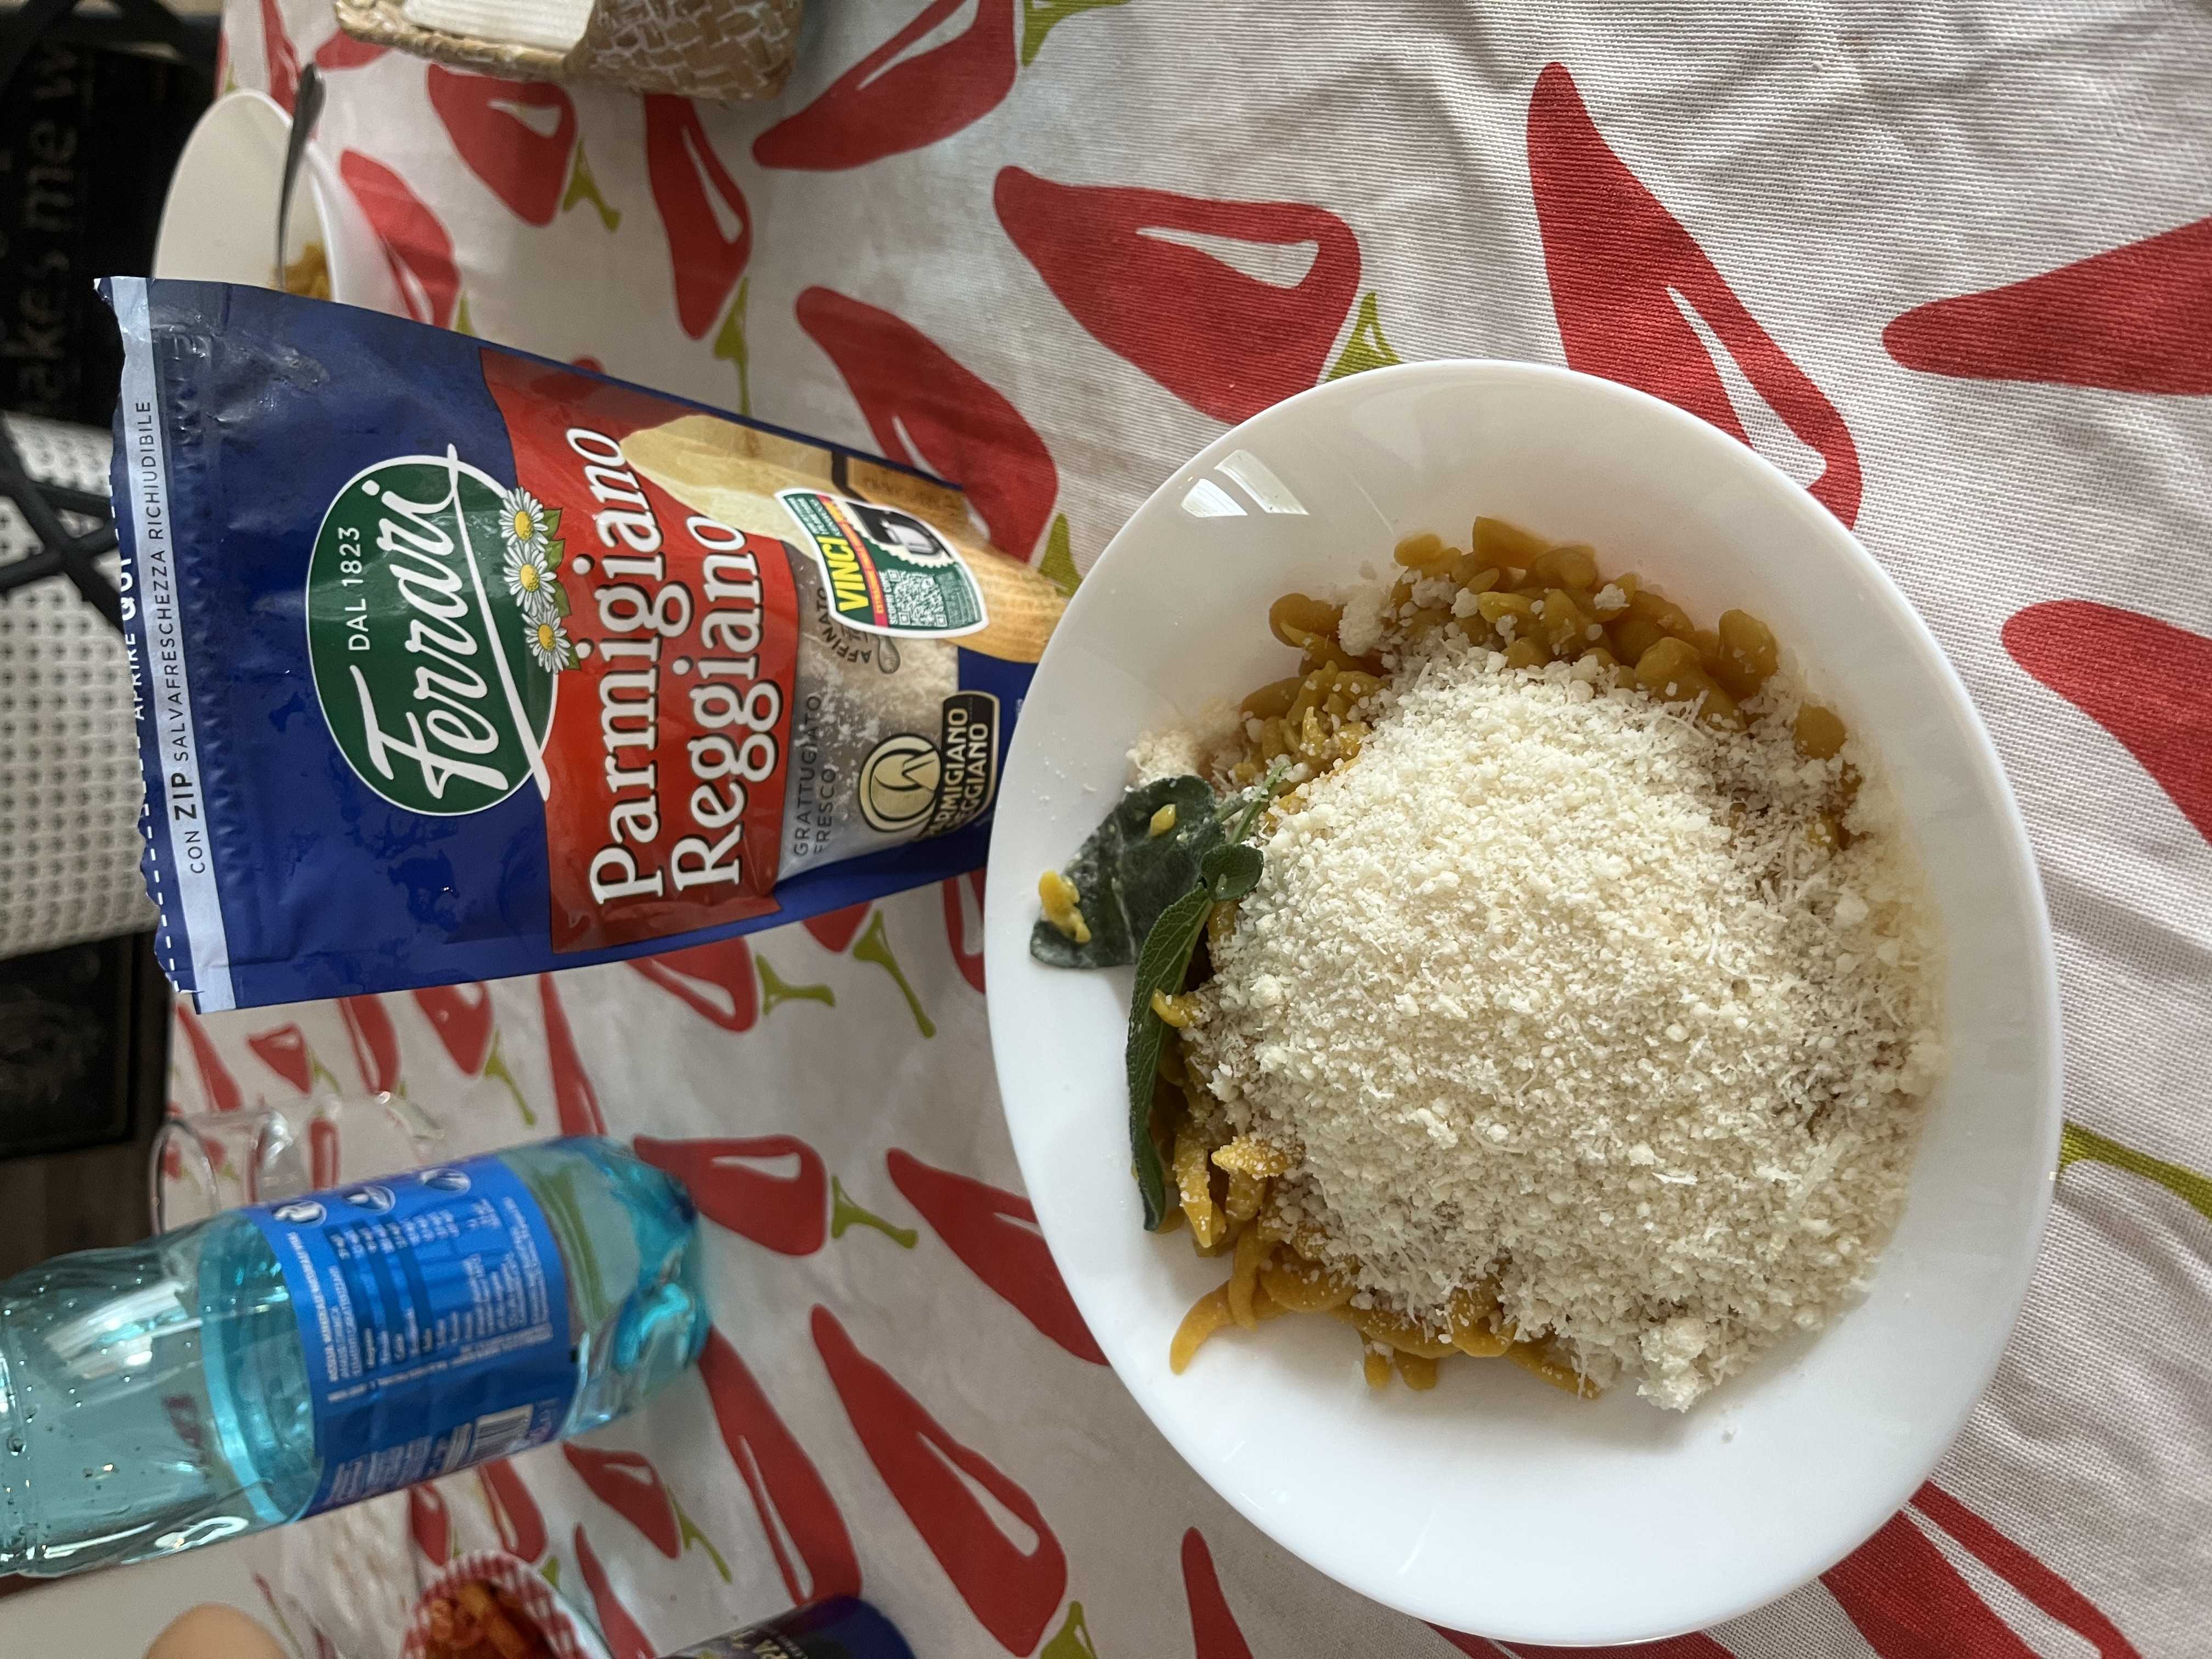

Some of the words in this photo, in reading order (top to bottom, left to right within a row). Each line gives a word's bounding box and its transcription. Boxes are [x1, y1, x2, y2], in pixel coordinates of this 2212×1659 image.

[135, 402, 163, 539] RICHIUDIBILE
[338, 527, 363, 586] 1823
[816, 535, 870, 612] VINCI
[150, 550, 189, 761] SALVAFRESCHEZZA
[345, 599, 371, 651] DAL
[349, 447, 527, 801] Ferrari
[565, 427, 690, 905] Parmigiano
[816, 587, 872, 664] AFFINATO
[671, 516, 780, 891] Reggiano
[171, 772, 198, 821] ZIP
[794, 696, 821, 857] GRATTUGIATO
[814, 769, 836, 854] FRESCO
[184, 830, 206, 874] CON
